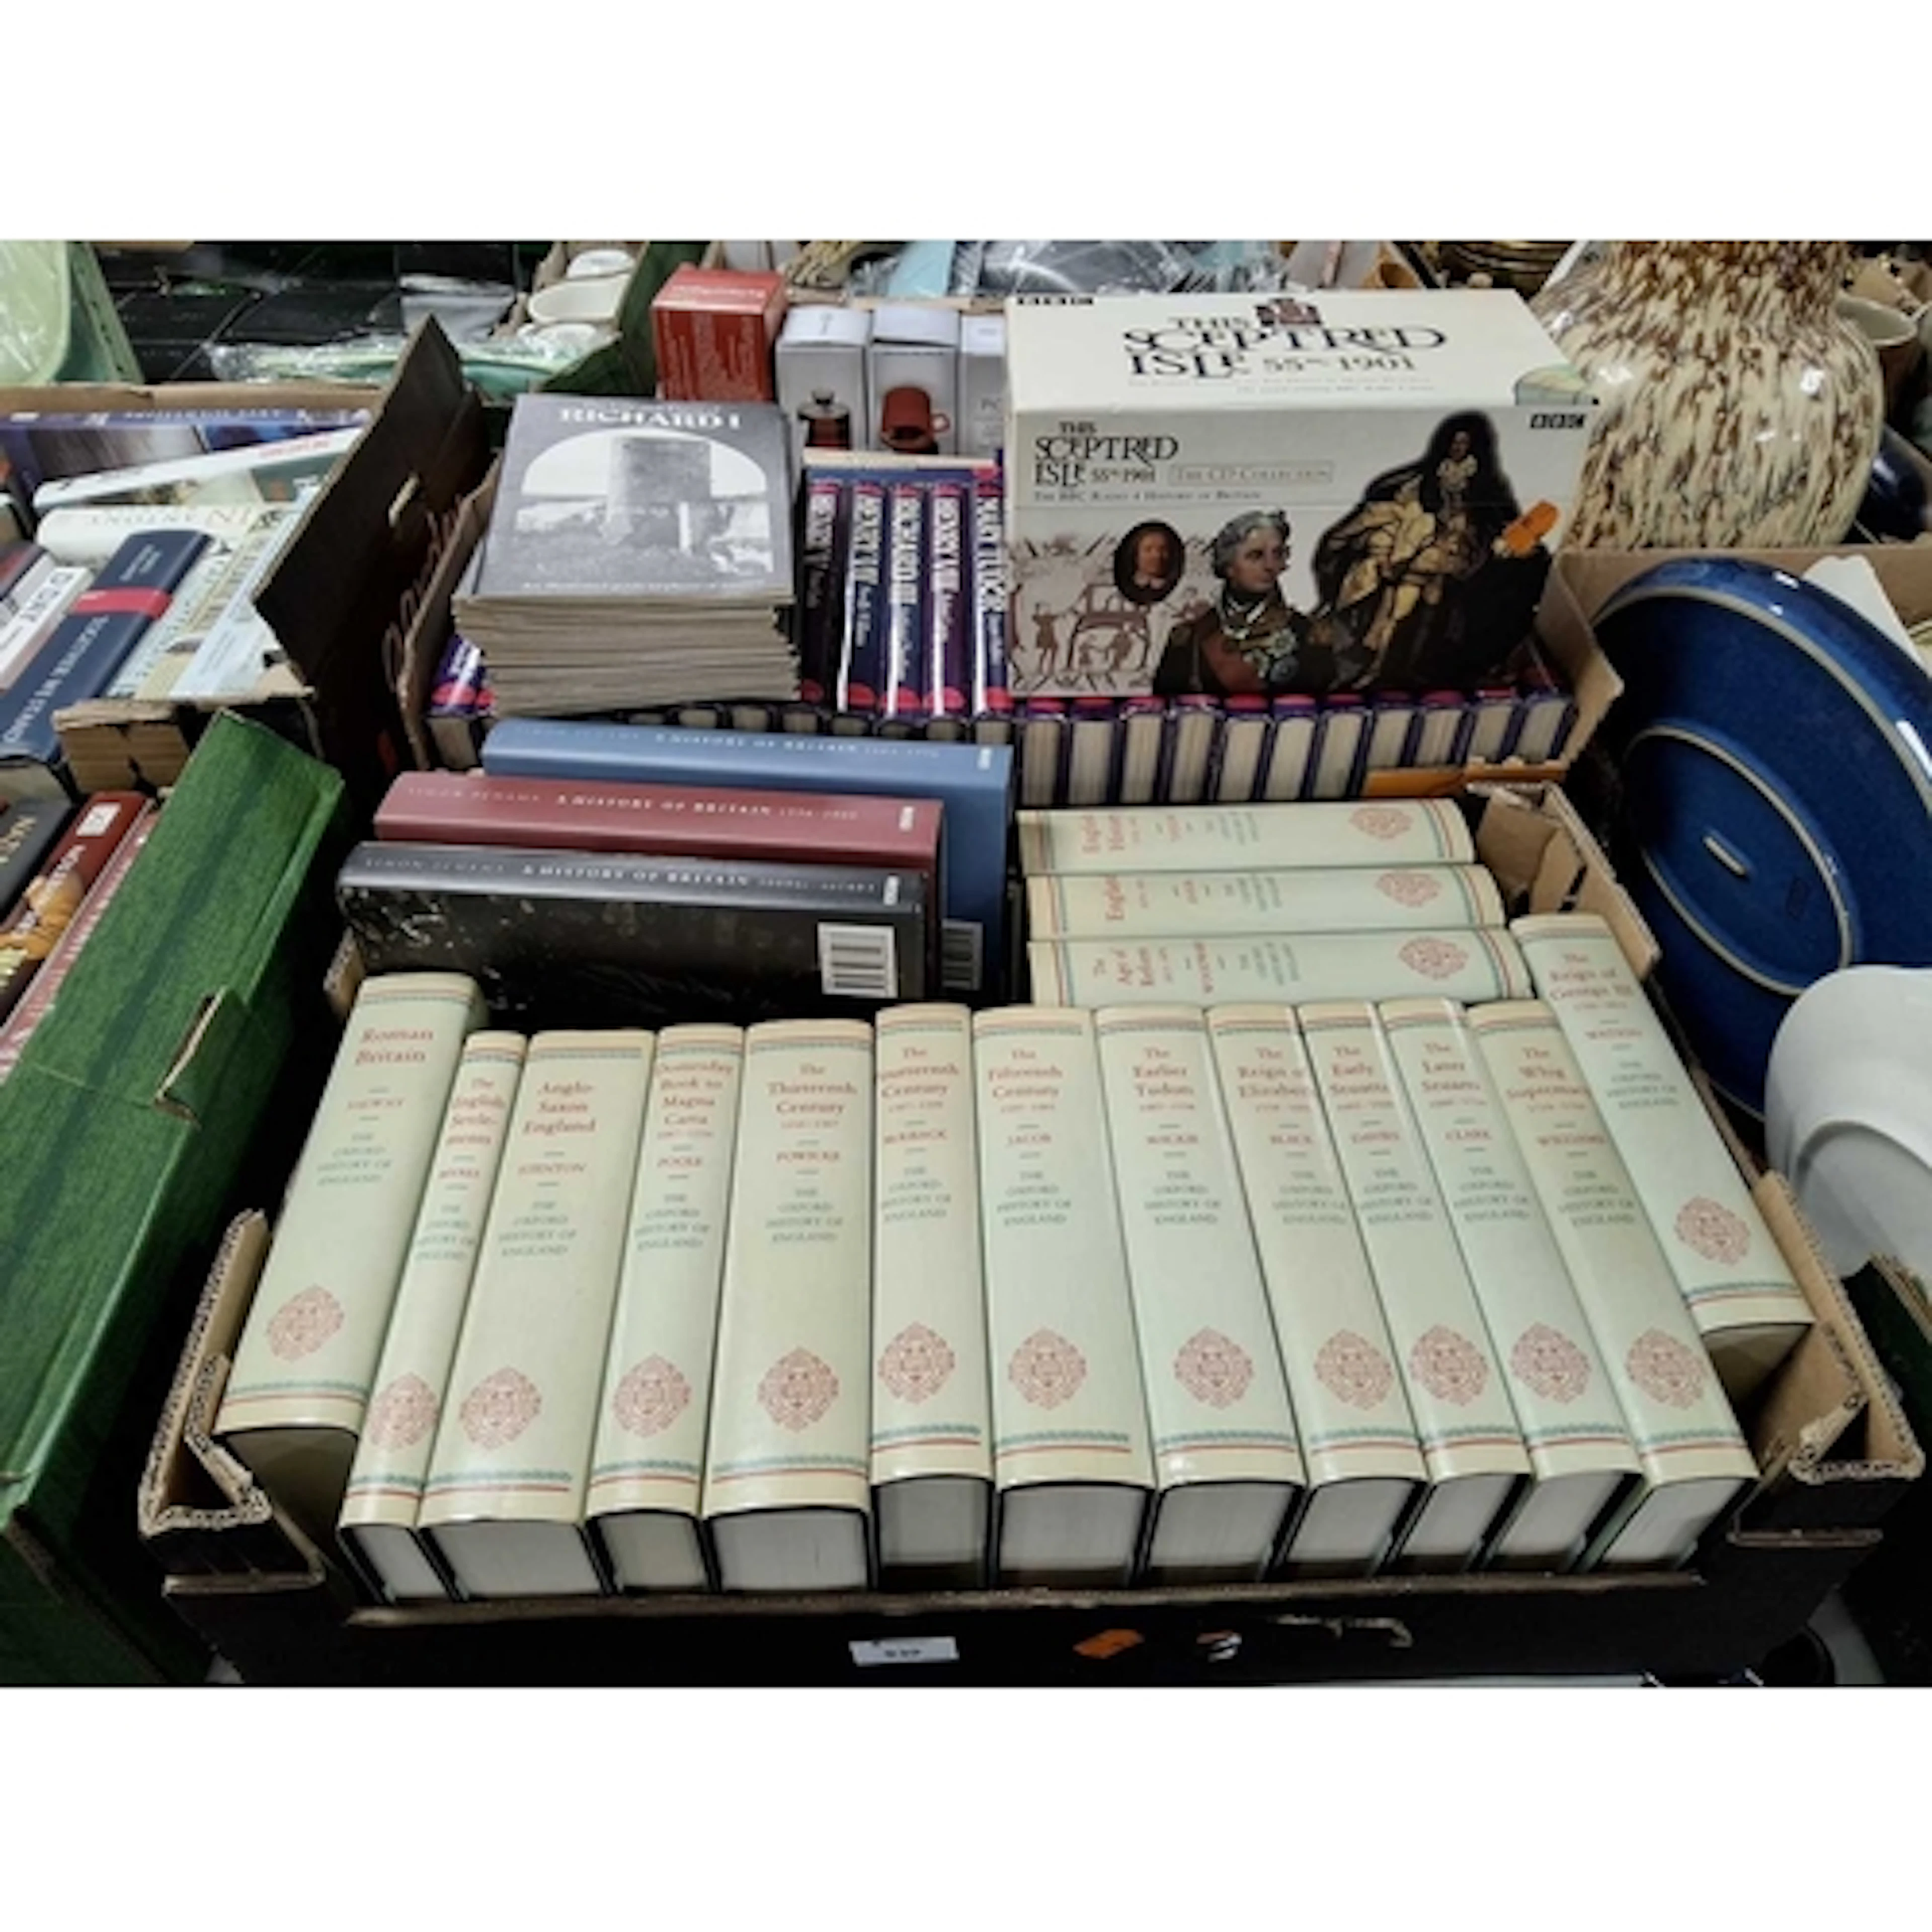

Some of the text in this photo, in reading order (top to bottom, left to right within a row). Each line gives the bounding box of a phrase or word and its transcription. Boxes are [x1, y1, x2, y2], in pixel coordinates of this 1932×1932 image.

[559, 407, 725, 429] RICHARD
[361, 1027, 434, 1043] Roman
[355, 1048, 428, 1066] Britain
[767, 1081, 858, 1096] Thirteenth
[880, 1083, 948, 1099] Century
[775, 1100, 845, 1116] Century
[523, 1117, 597, 1136] England
